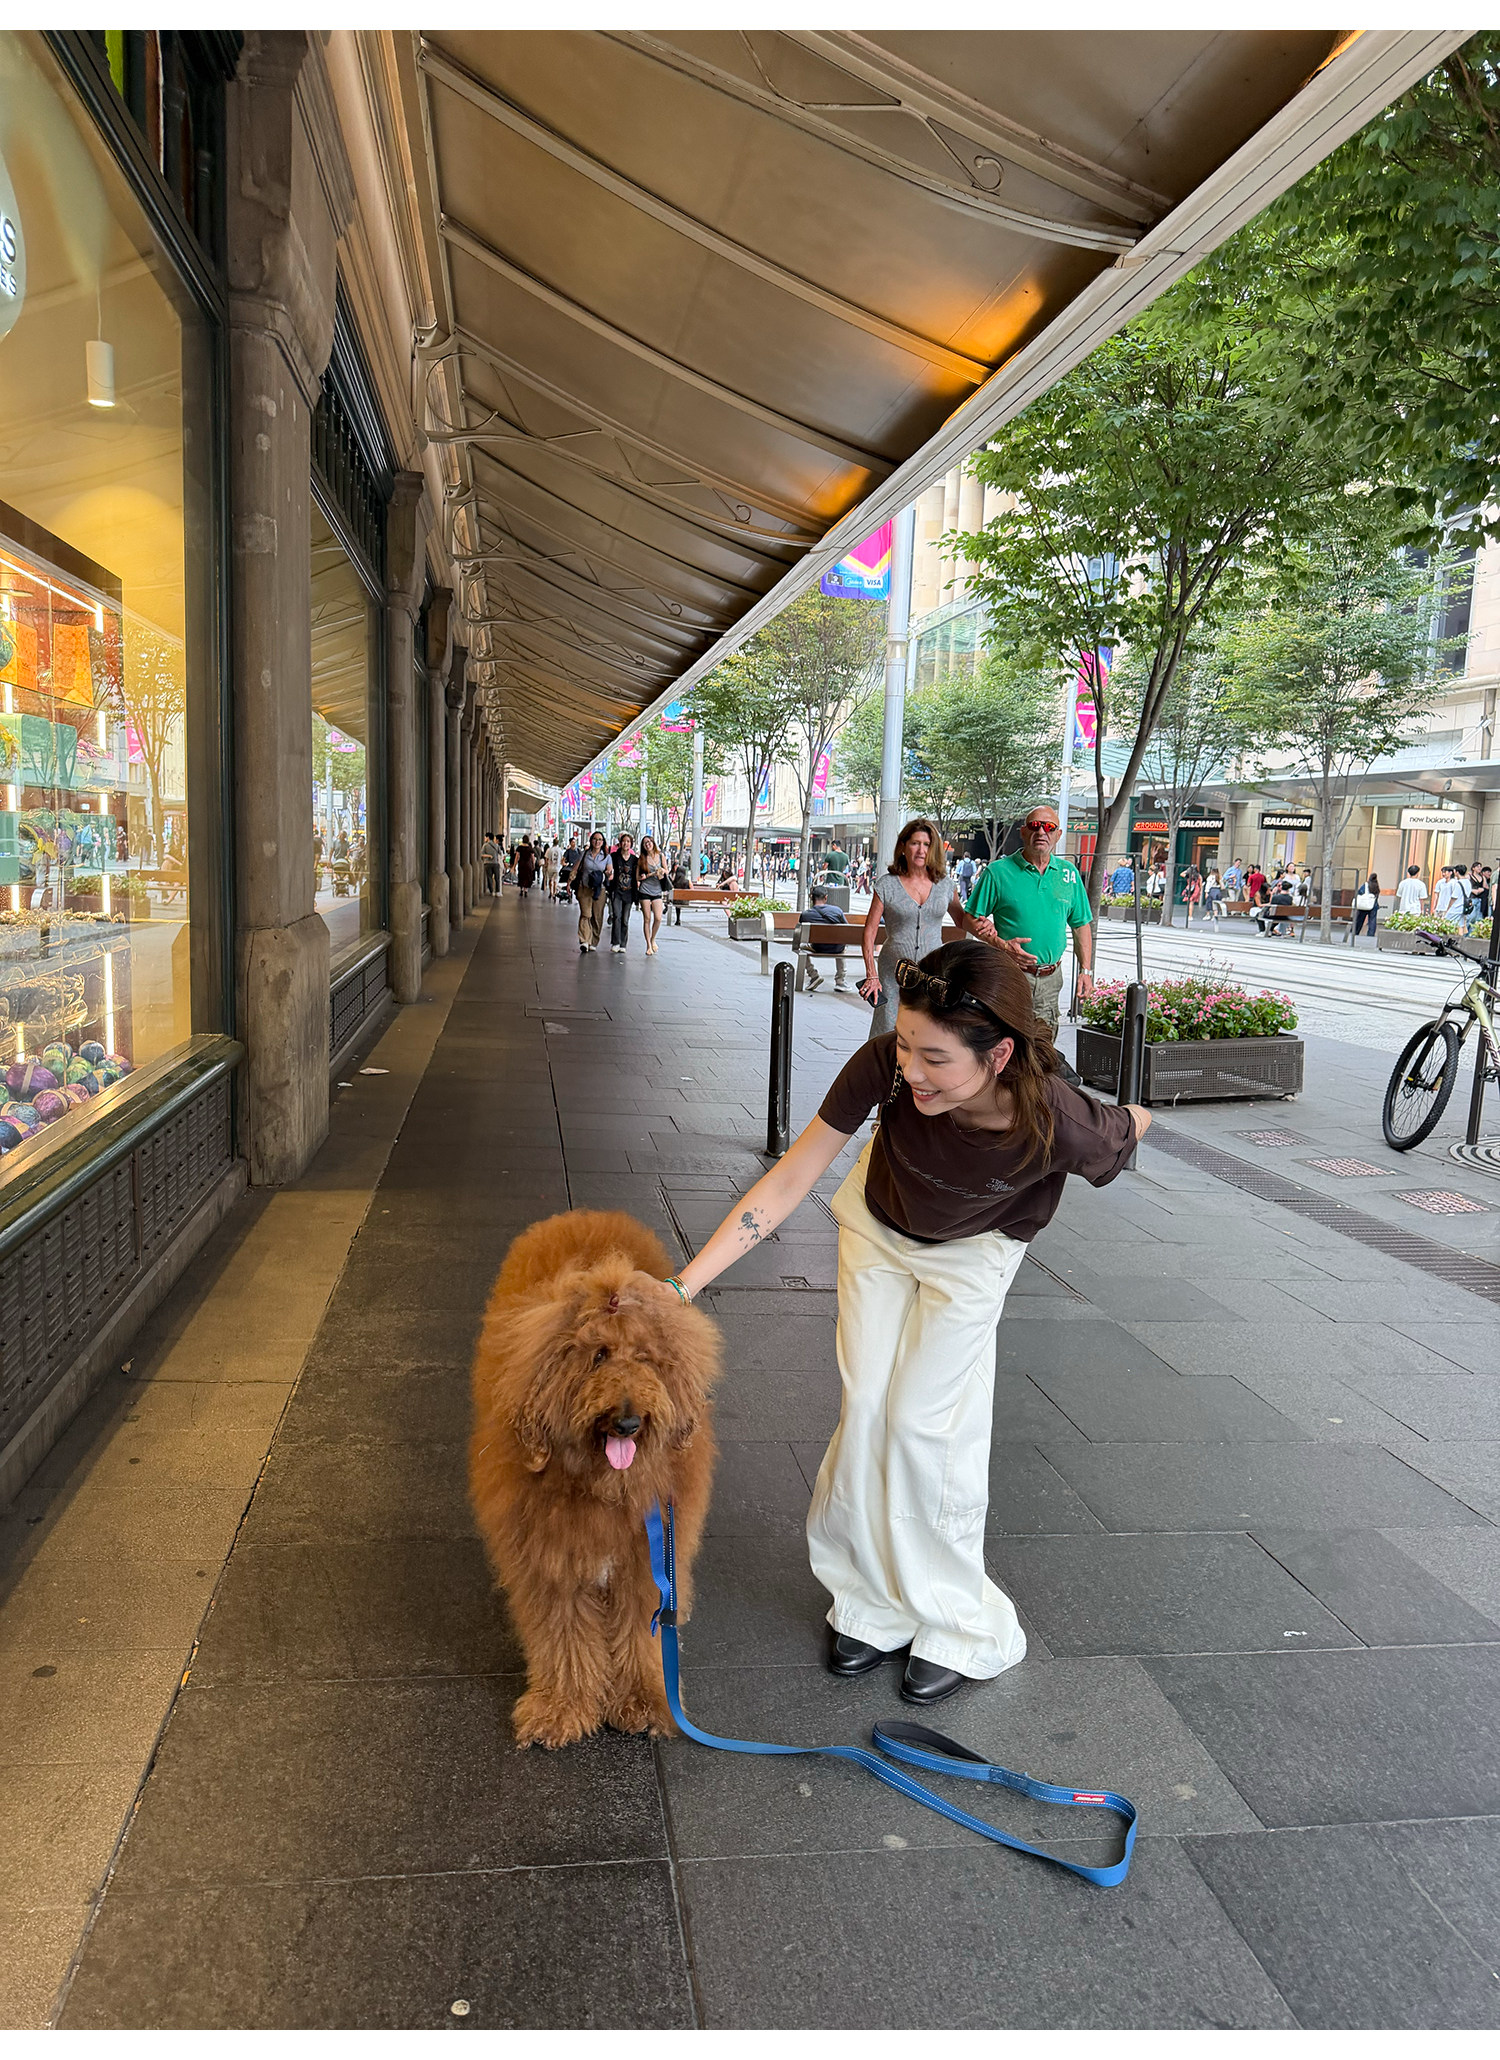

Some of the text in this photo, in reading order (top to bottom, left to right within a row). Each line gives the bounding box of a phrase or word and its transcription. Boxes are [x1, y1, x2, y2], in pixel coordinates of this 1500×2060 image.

[1178, 820, 1222, 828] SALOMON
[1262, 817, 1311, 827] SALOMON
[1425, 816, 1456, 824] balance
[1135, 822, 1168, 830] GROUNDS
